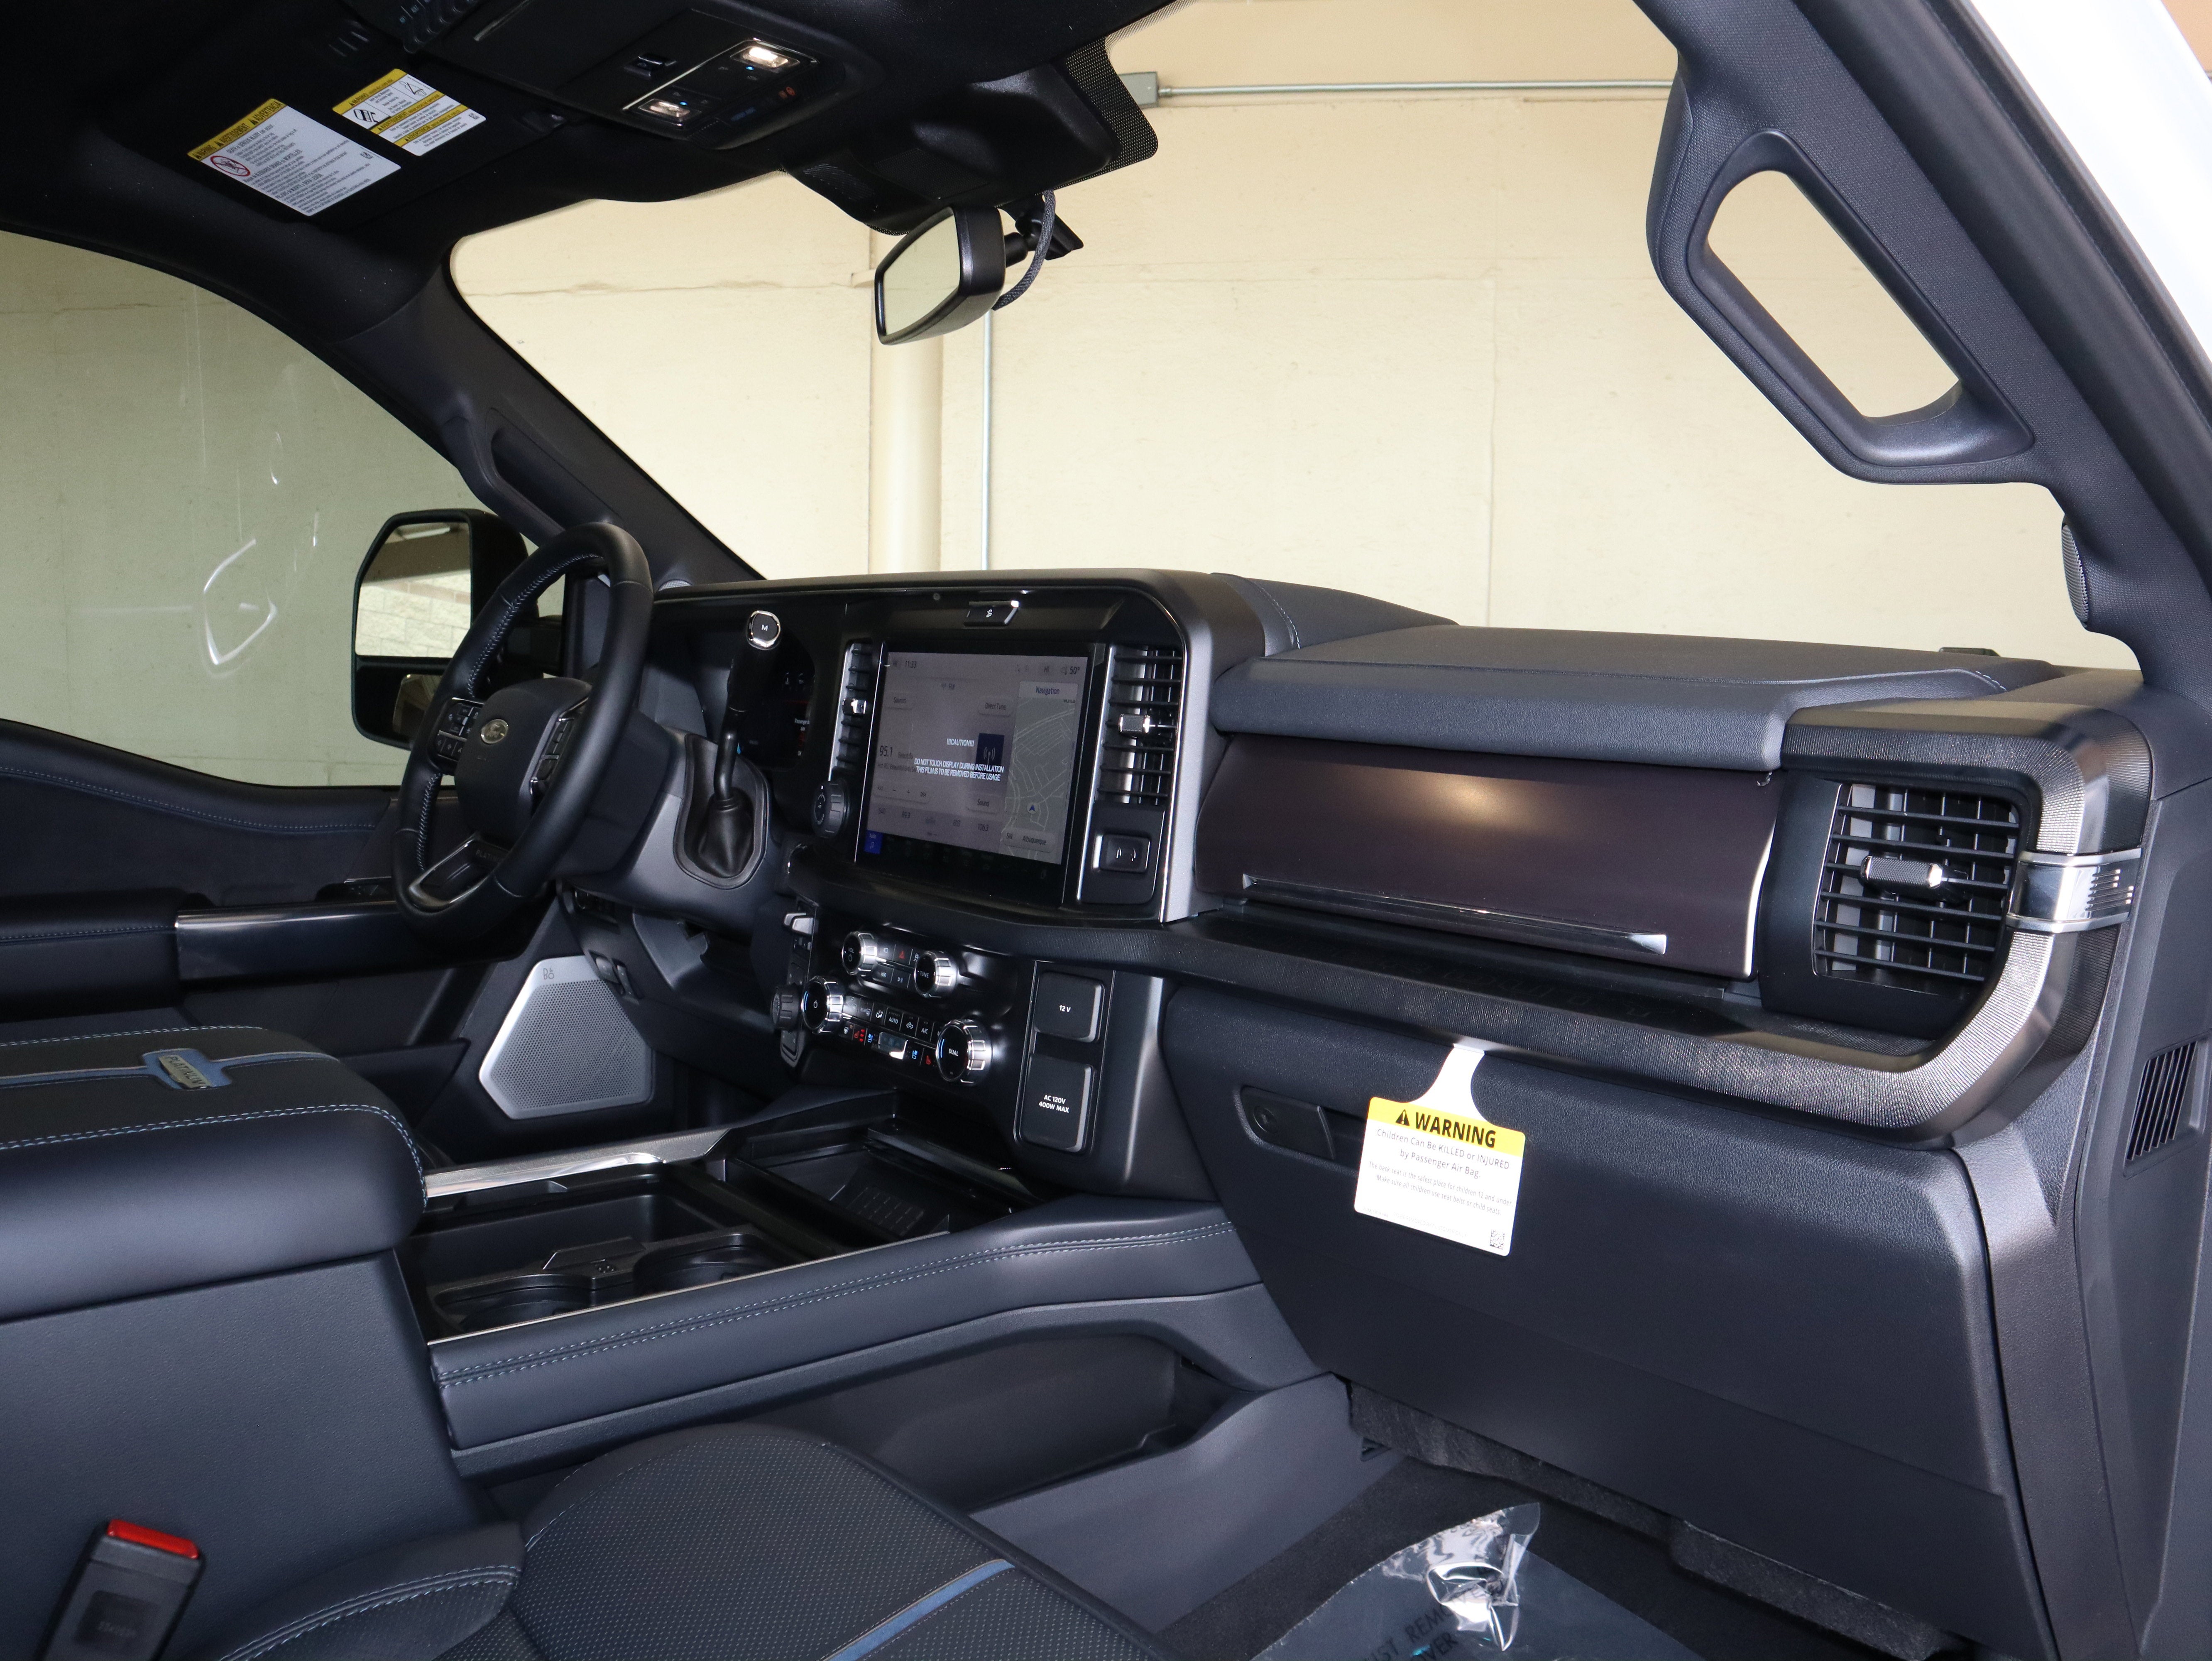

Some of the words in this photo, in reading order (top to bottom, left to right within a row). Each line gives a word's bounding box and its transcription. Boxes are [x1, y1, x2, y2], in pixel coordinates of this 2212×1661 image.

[1036, 686, 1060, 695] Navigation
[880, 745, 892, 757] 95.1
[975, 764, 1004, 773] INSTALLATION
[1023, 835, 1047, 845] Albuquerque
[888, 1017, 898, 1025] AUTO
[948, 1048, 959, 1057] DUAL
[169, 1056, 206, 1085] PLATINUM
[1052, 1096, 1066, 1104] 120V
[1038, 1101, 1056, 1110] 400W
[1056, 1105, 1069, 1113] MAX
[1416, 1112, 1496, 1148] WARNING
[1377, 1129, 1408, 1144] Children
[1411, 1137, 1424, 1147] Can
[1427, 1141, 1436, 1150] Be
[1439, 1144, 1465, 1157] KILLED
[1477, 1154, 1510, 1169] INJURED
[1400, 1149, 1409, 1160] by
[1412, 1152, 1450, 1169] Passenger
[1451, 1163, 1463, 1172] Air
[1465, 1166, 1480, 1179] Bag.
[1379, 1164, 1390, 1172] back
[1418, 1175, 1432, 1184] safest
[1433, 1180, 1446, 1188] place
[1456, 1186, 1476, 1197] children
[1485, 1193, 1495, 1202] and
[1496, 1196, 1514, 1207] under.
[1377, 1174, 1390, 1184] Make
[1411, 1184, 1430, 1195] children
[1441, 1193, 1451, 1201] seat
[1453, 1196, 1465, 1205] belts
[1473, 1201, 1485, 1211] child
[1487, 1205, 1501, 1215] seats.
